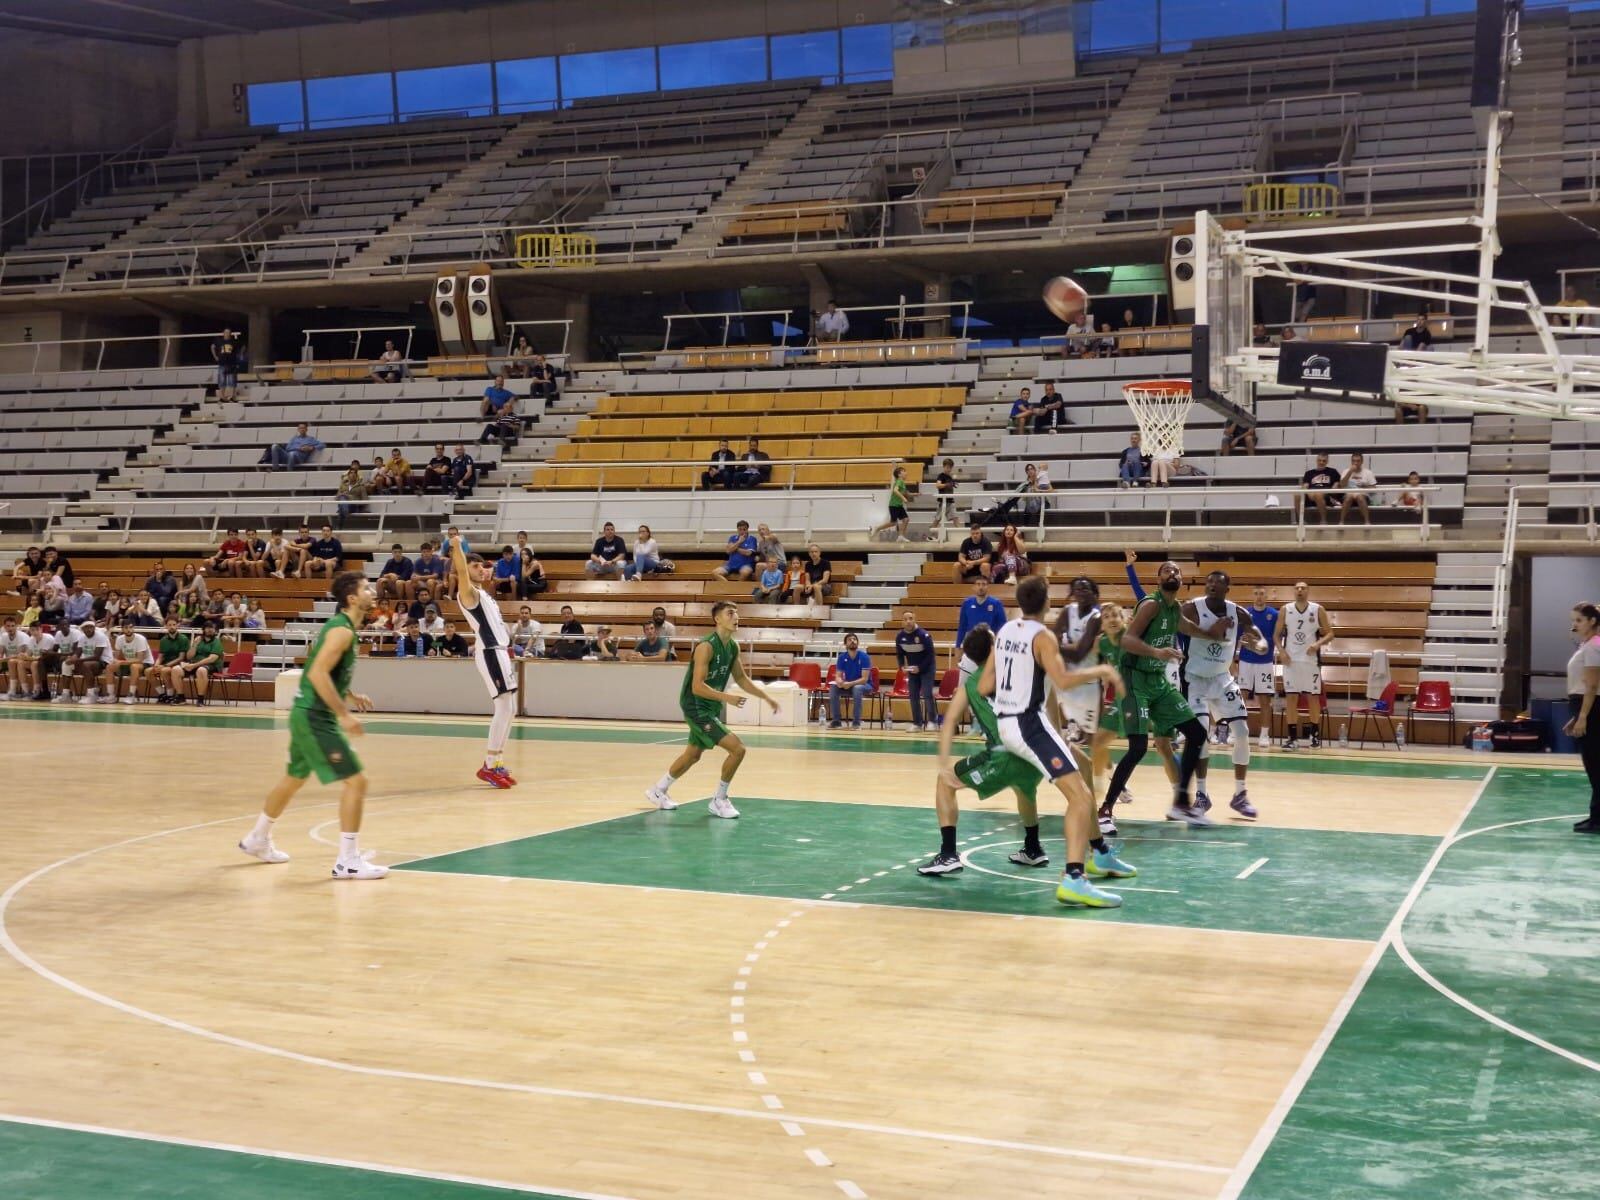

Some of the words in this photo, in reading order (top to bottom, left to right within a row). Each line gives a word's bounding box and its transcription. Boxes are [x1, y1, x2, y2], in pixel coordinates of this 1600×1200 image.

[1297, 620, 1305, 630] 7
[1261, 673, 1272, 683] 24
[1313, 674, 1320, 684] 7
